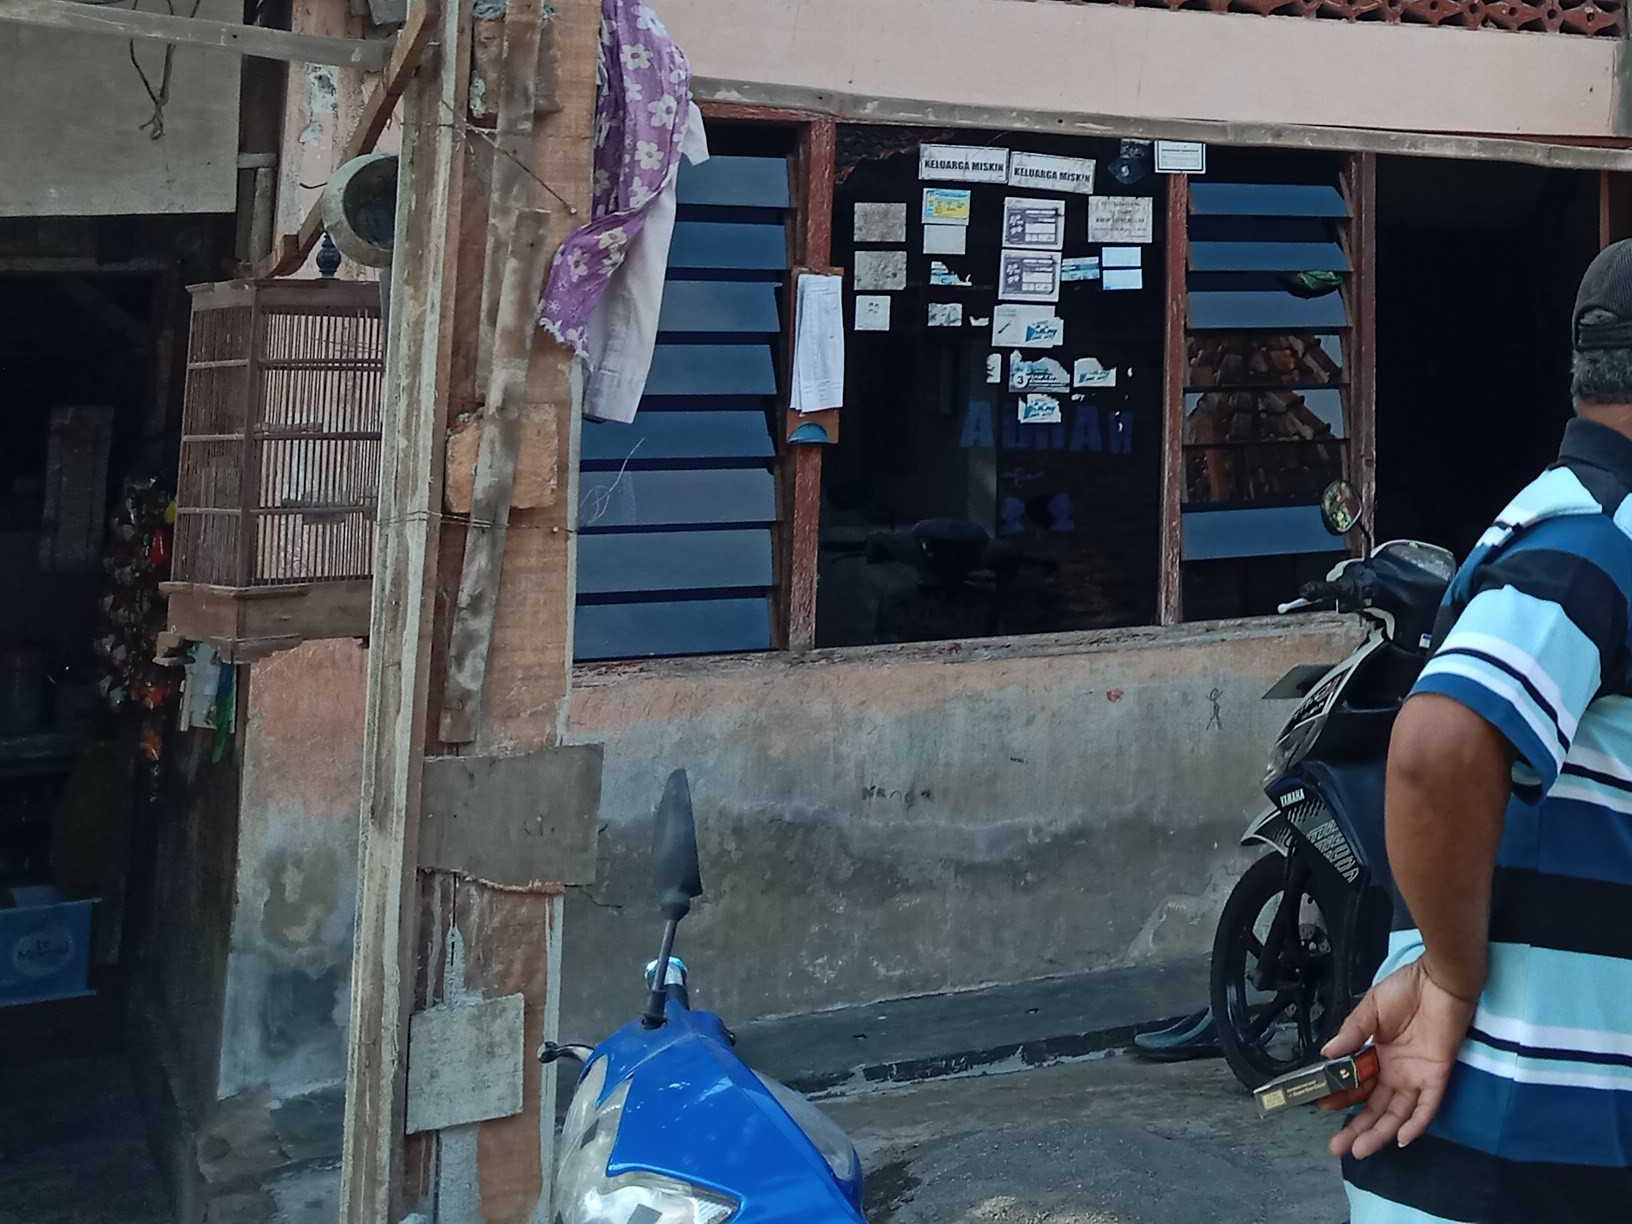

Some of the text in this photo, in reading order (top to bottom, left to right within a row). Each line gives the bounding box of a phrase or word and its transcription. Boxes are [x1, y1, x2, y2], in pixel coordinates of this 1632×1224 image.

[924, 159, 1004, 172] KELUARGA MISKIN
[1013, 167, 1090, 183] KELUARGA MISKIN
